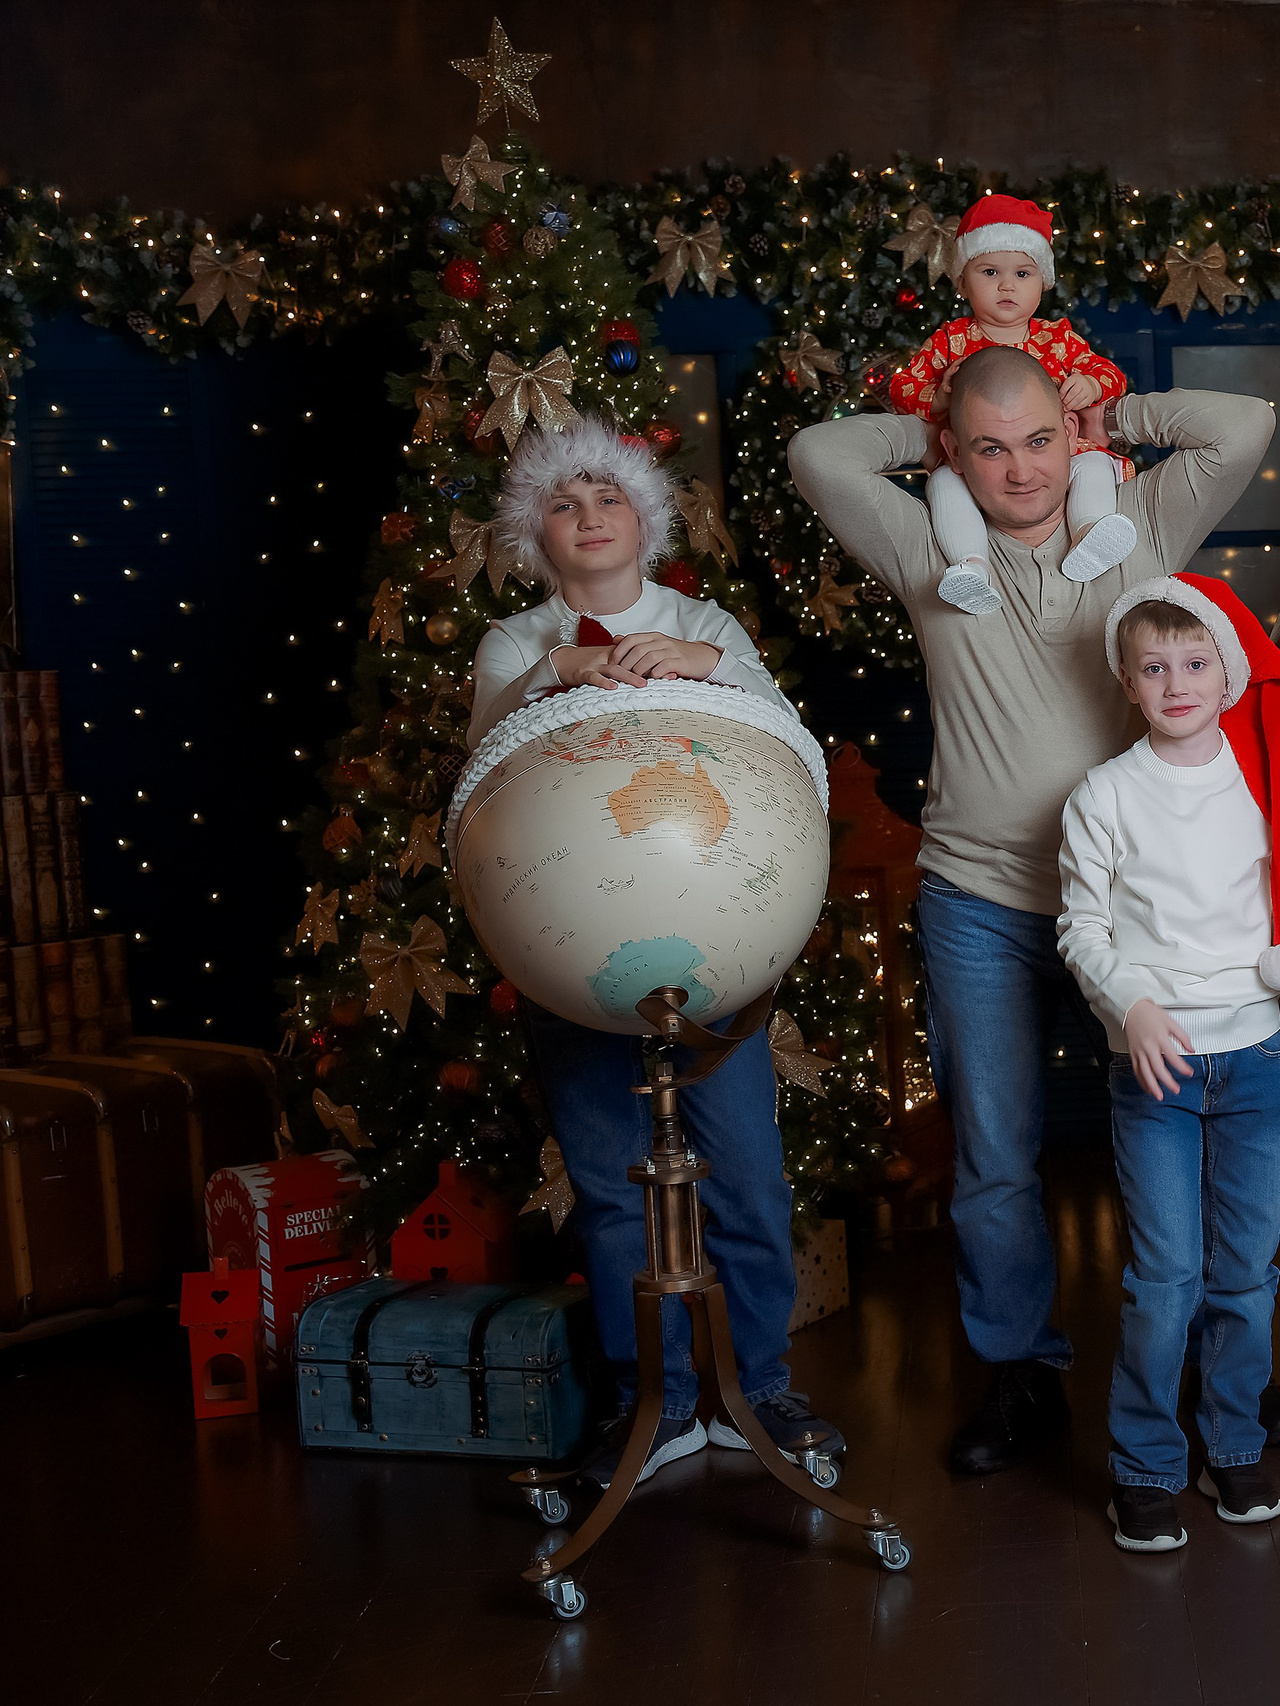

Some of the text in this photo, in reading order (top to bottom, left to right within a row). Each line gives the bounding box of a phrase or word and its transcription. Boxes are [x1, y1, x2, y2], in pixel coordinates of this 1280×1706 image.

[502, 846, 569, 904] ИНДИЙСКИЙ ОКЕАН
[213, 1188, 249, 1225] Believe
